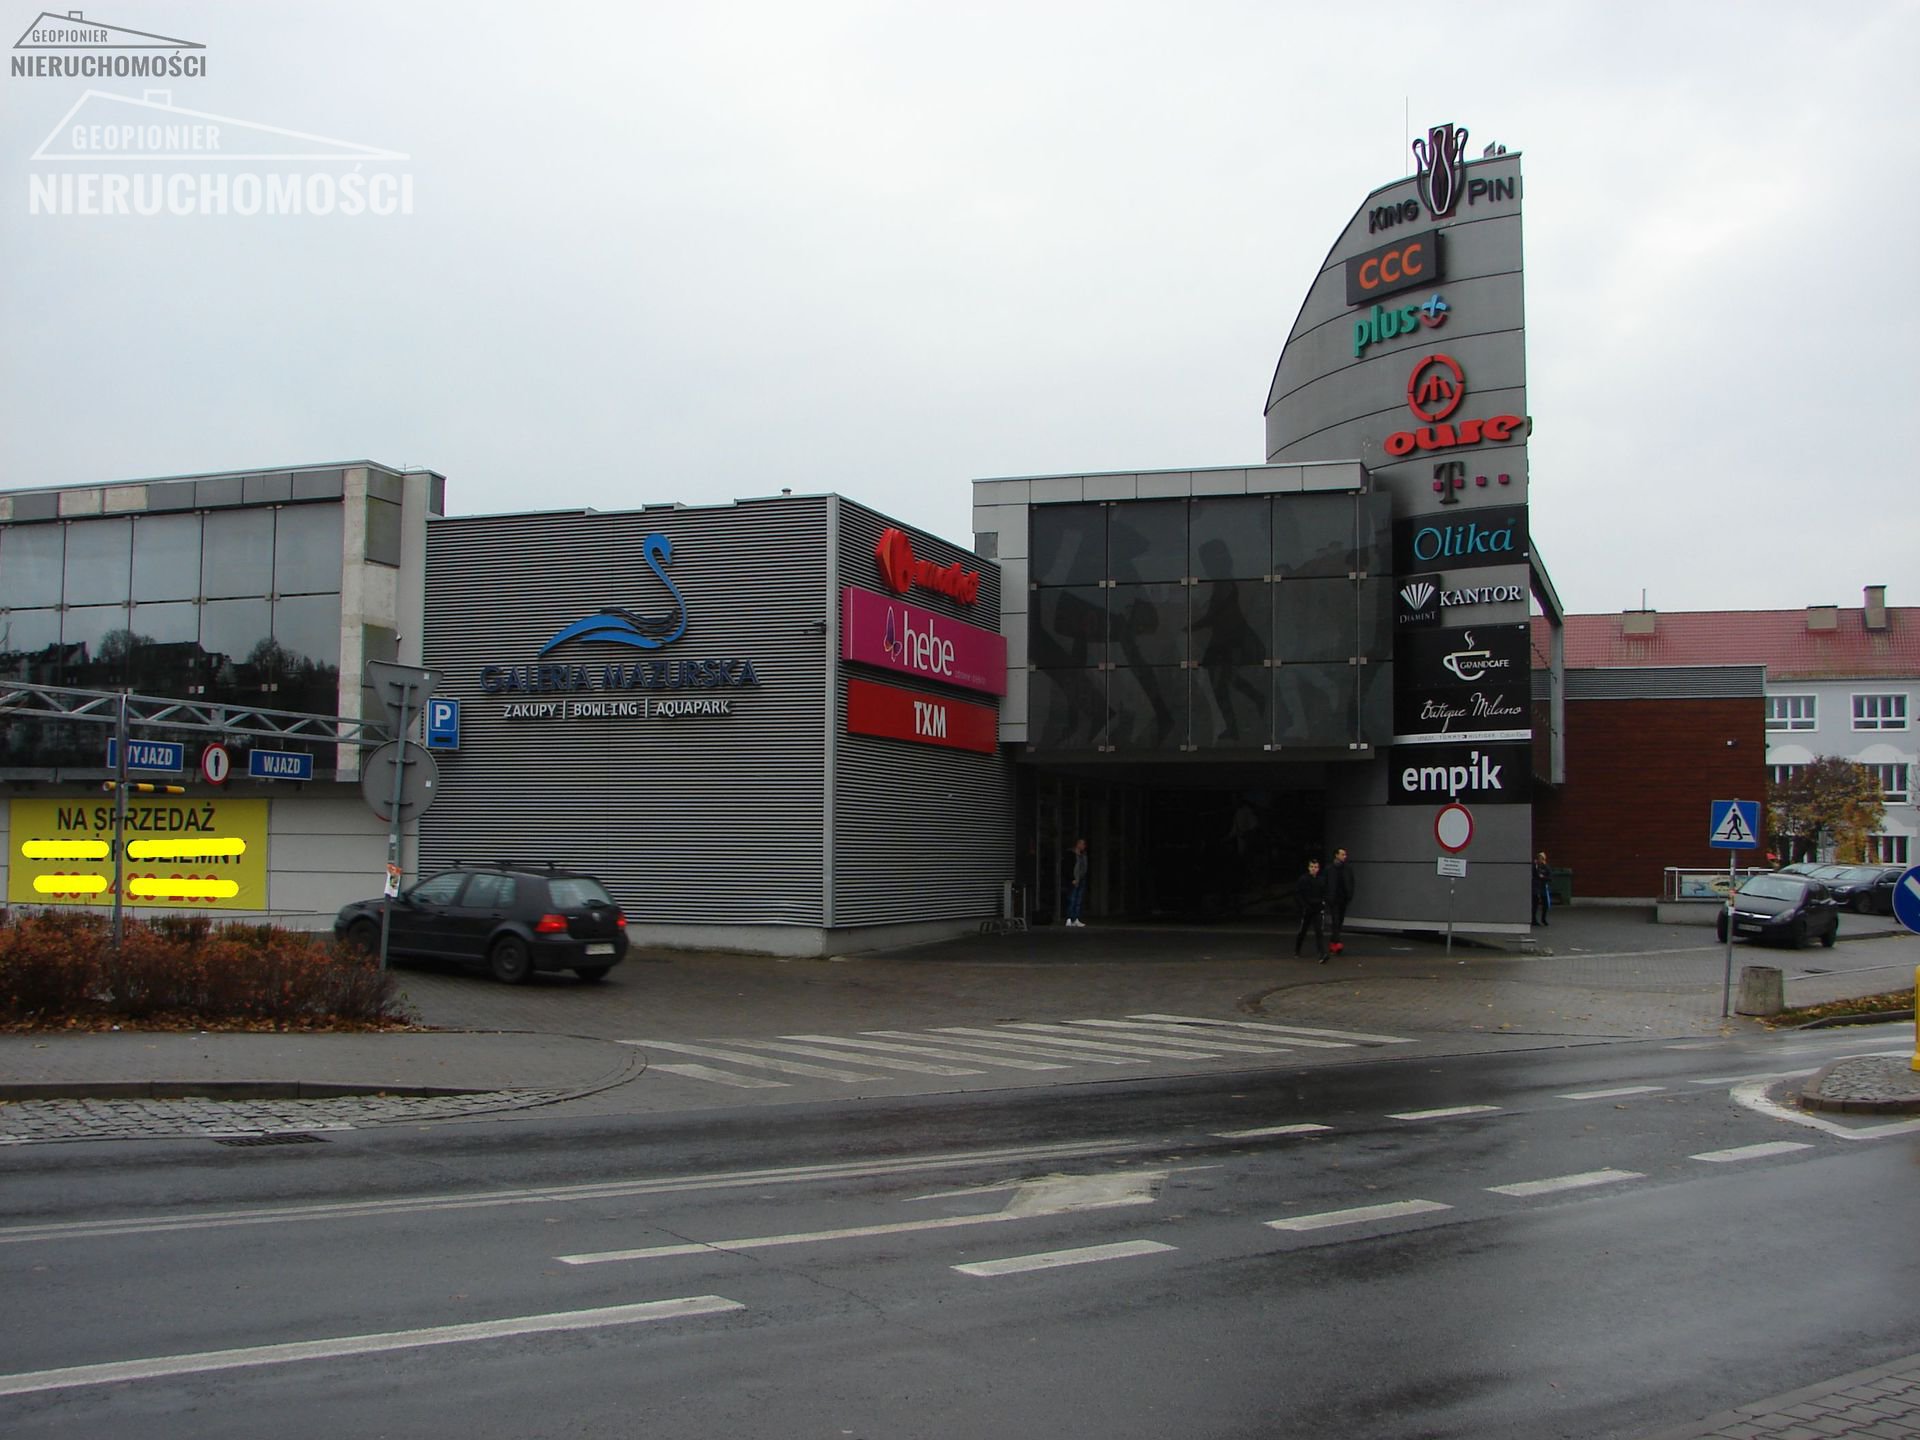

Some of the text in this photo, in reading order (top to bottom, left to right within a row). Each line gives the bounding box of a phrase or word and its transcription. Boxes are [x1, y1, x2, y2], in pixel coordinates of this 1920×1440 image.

[1368, 176, 1515, 234] KING PIN
[1359, 243, 1422, 290] CCC
[1353, 303, 1420, 358] plus
[1414, 522, 1514, 561] Olika
[1439, 585, 1522, 607] KANTOR
[904, 610, 954, 677] hebe
[480, 659, 761, 694] GALERIA MAZURSKA
[435, 704, 452, 727] P
[504, 701, 730, 718] ZAKUPY BOWLING AQUAPARK
[914, 701, 947, 738] TXM
[264, 756, 301, 775] WJAZD
[1402, 751, 1502, 797] empik
[57, 808, 88, 830] NA
